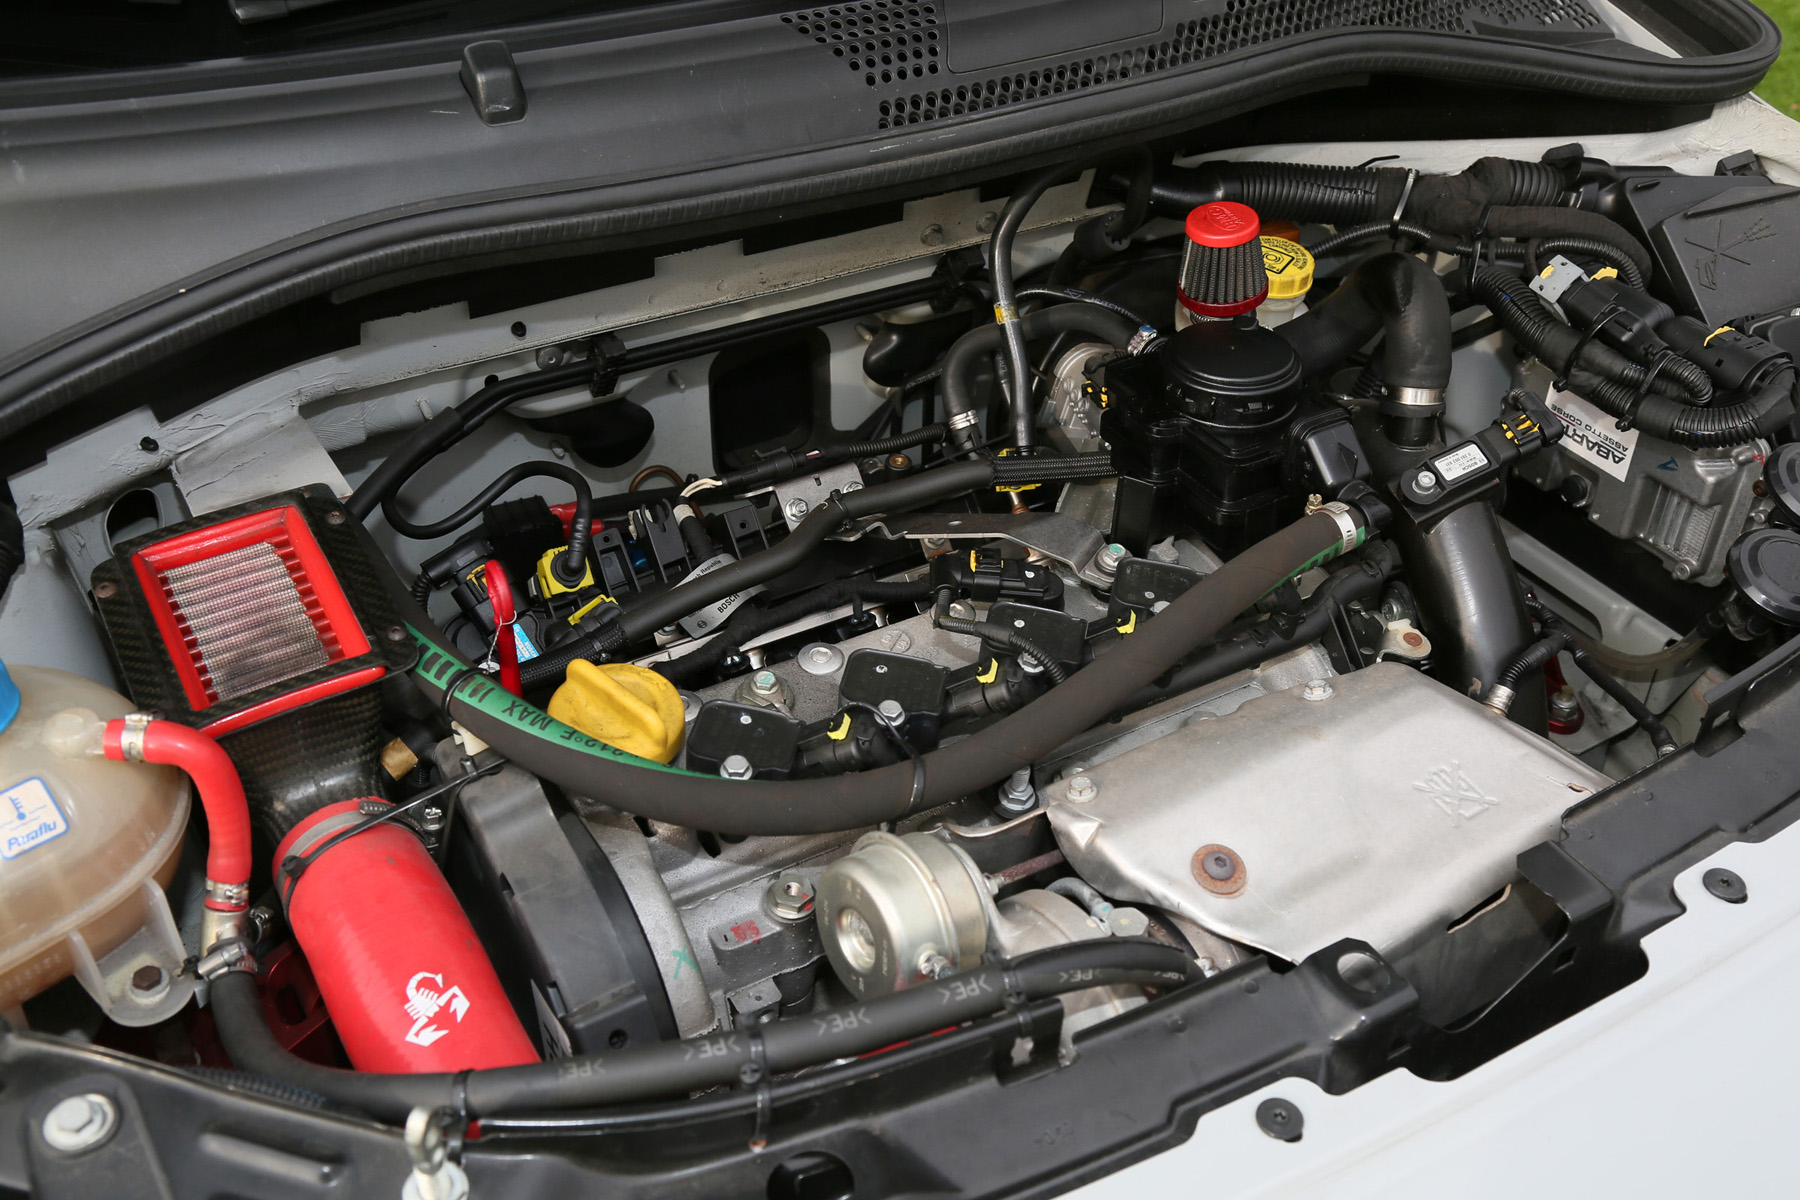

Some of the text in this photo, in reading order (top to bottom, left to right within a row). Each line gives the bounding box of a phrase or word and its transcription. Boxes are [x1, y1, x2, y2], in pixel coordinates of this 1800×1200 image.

[1550, 403, 1629, 453] ASSETTO CORSE
[1564, 424, 1626, 465] ABART
[1461, 460, 1479, 471] BOSCH
[717, 592, 740, 613] BOSCH
[501, 700, 553, 731] MAX
[7, 821, 57, 851] Paraflu
